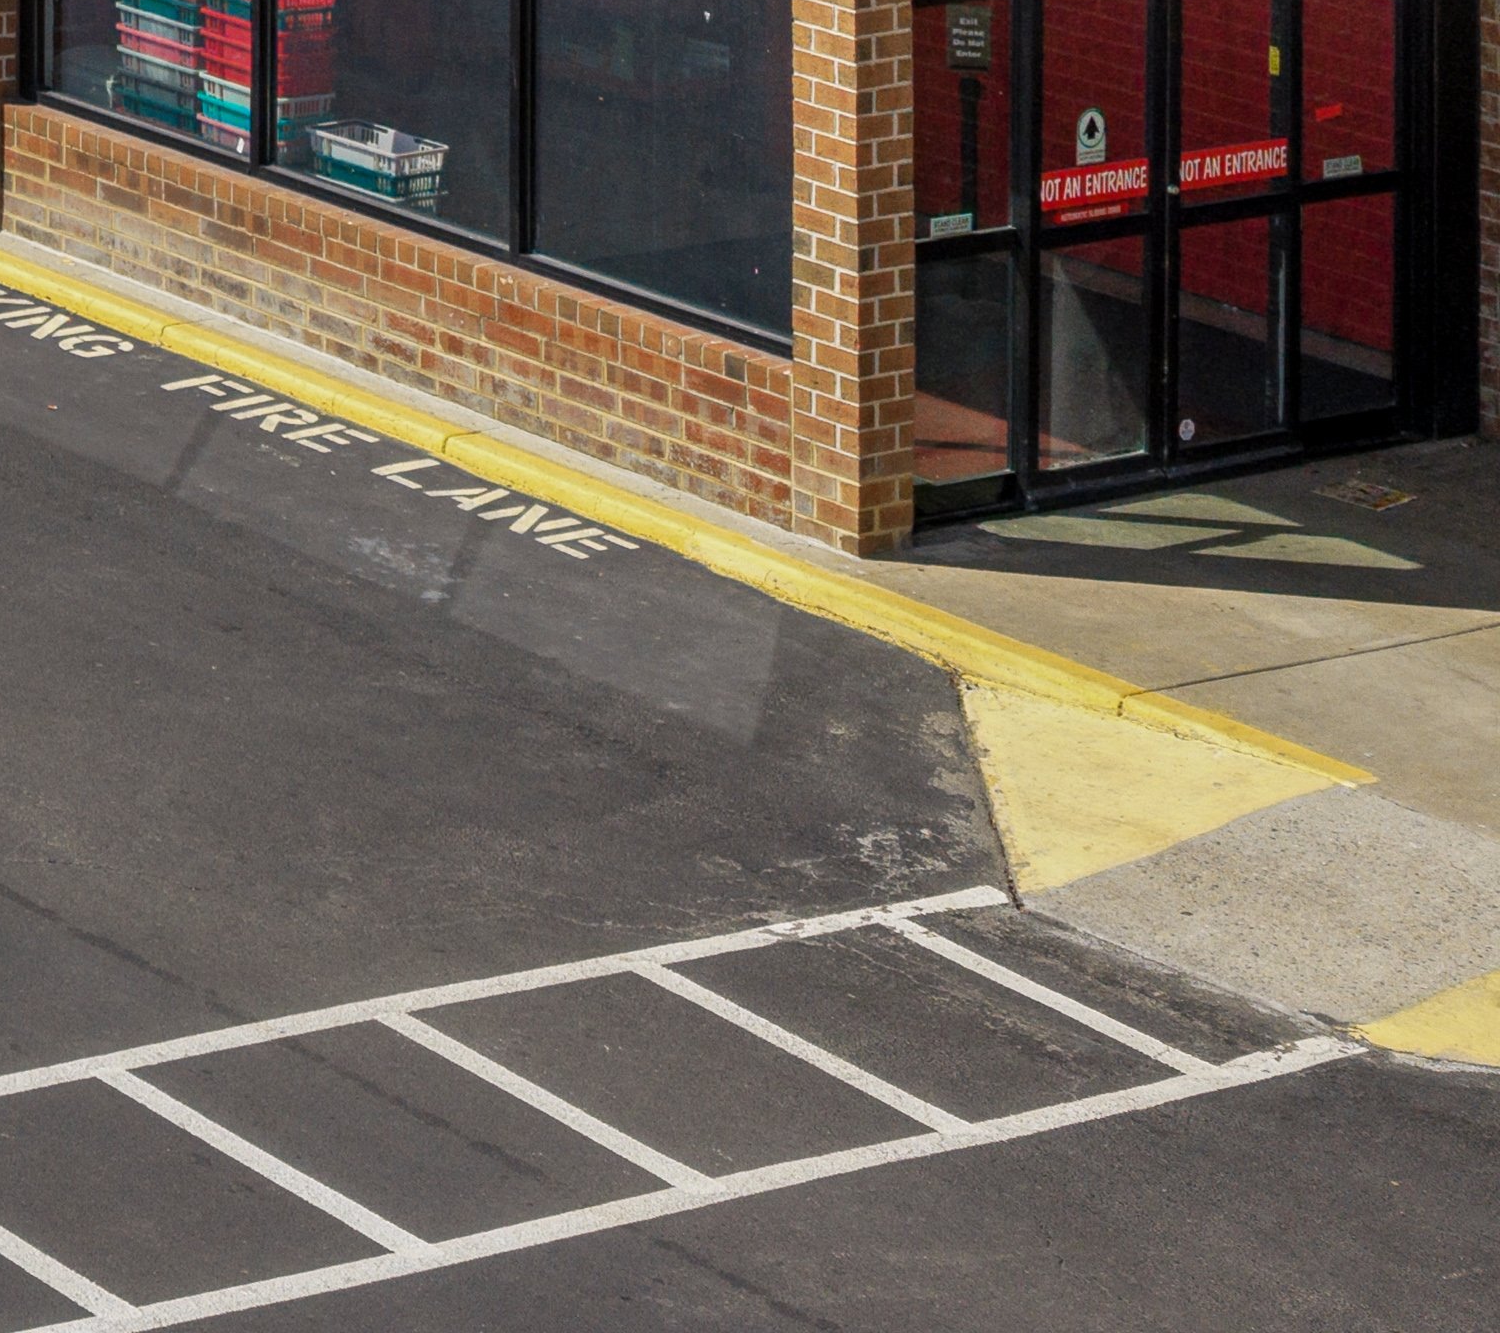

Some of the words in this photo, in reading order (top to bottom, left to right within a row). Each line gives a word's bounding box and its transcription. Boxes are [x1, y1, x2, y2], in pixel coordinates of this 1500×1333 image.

[1203, 155, 1221, 180] AN
[1225, 145, 1288, 176] ENTRANCE
[1063, 175, 1082, 201] AN
[1085, 165, 1148, 197] ENTRANCE
[159, 374, 381, 454] FIRE
[369, 458, 641, 561] LANE
